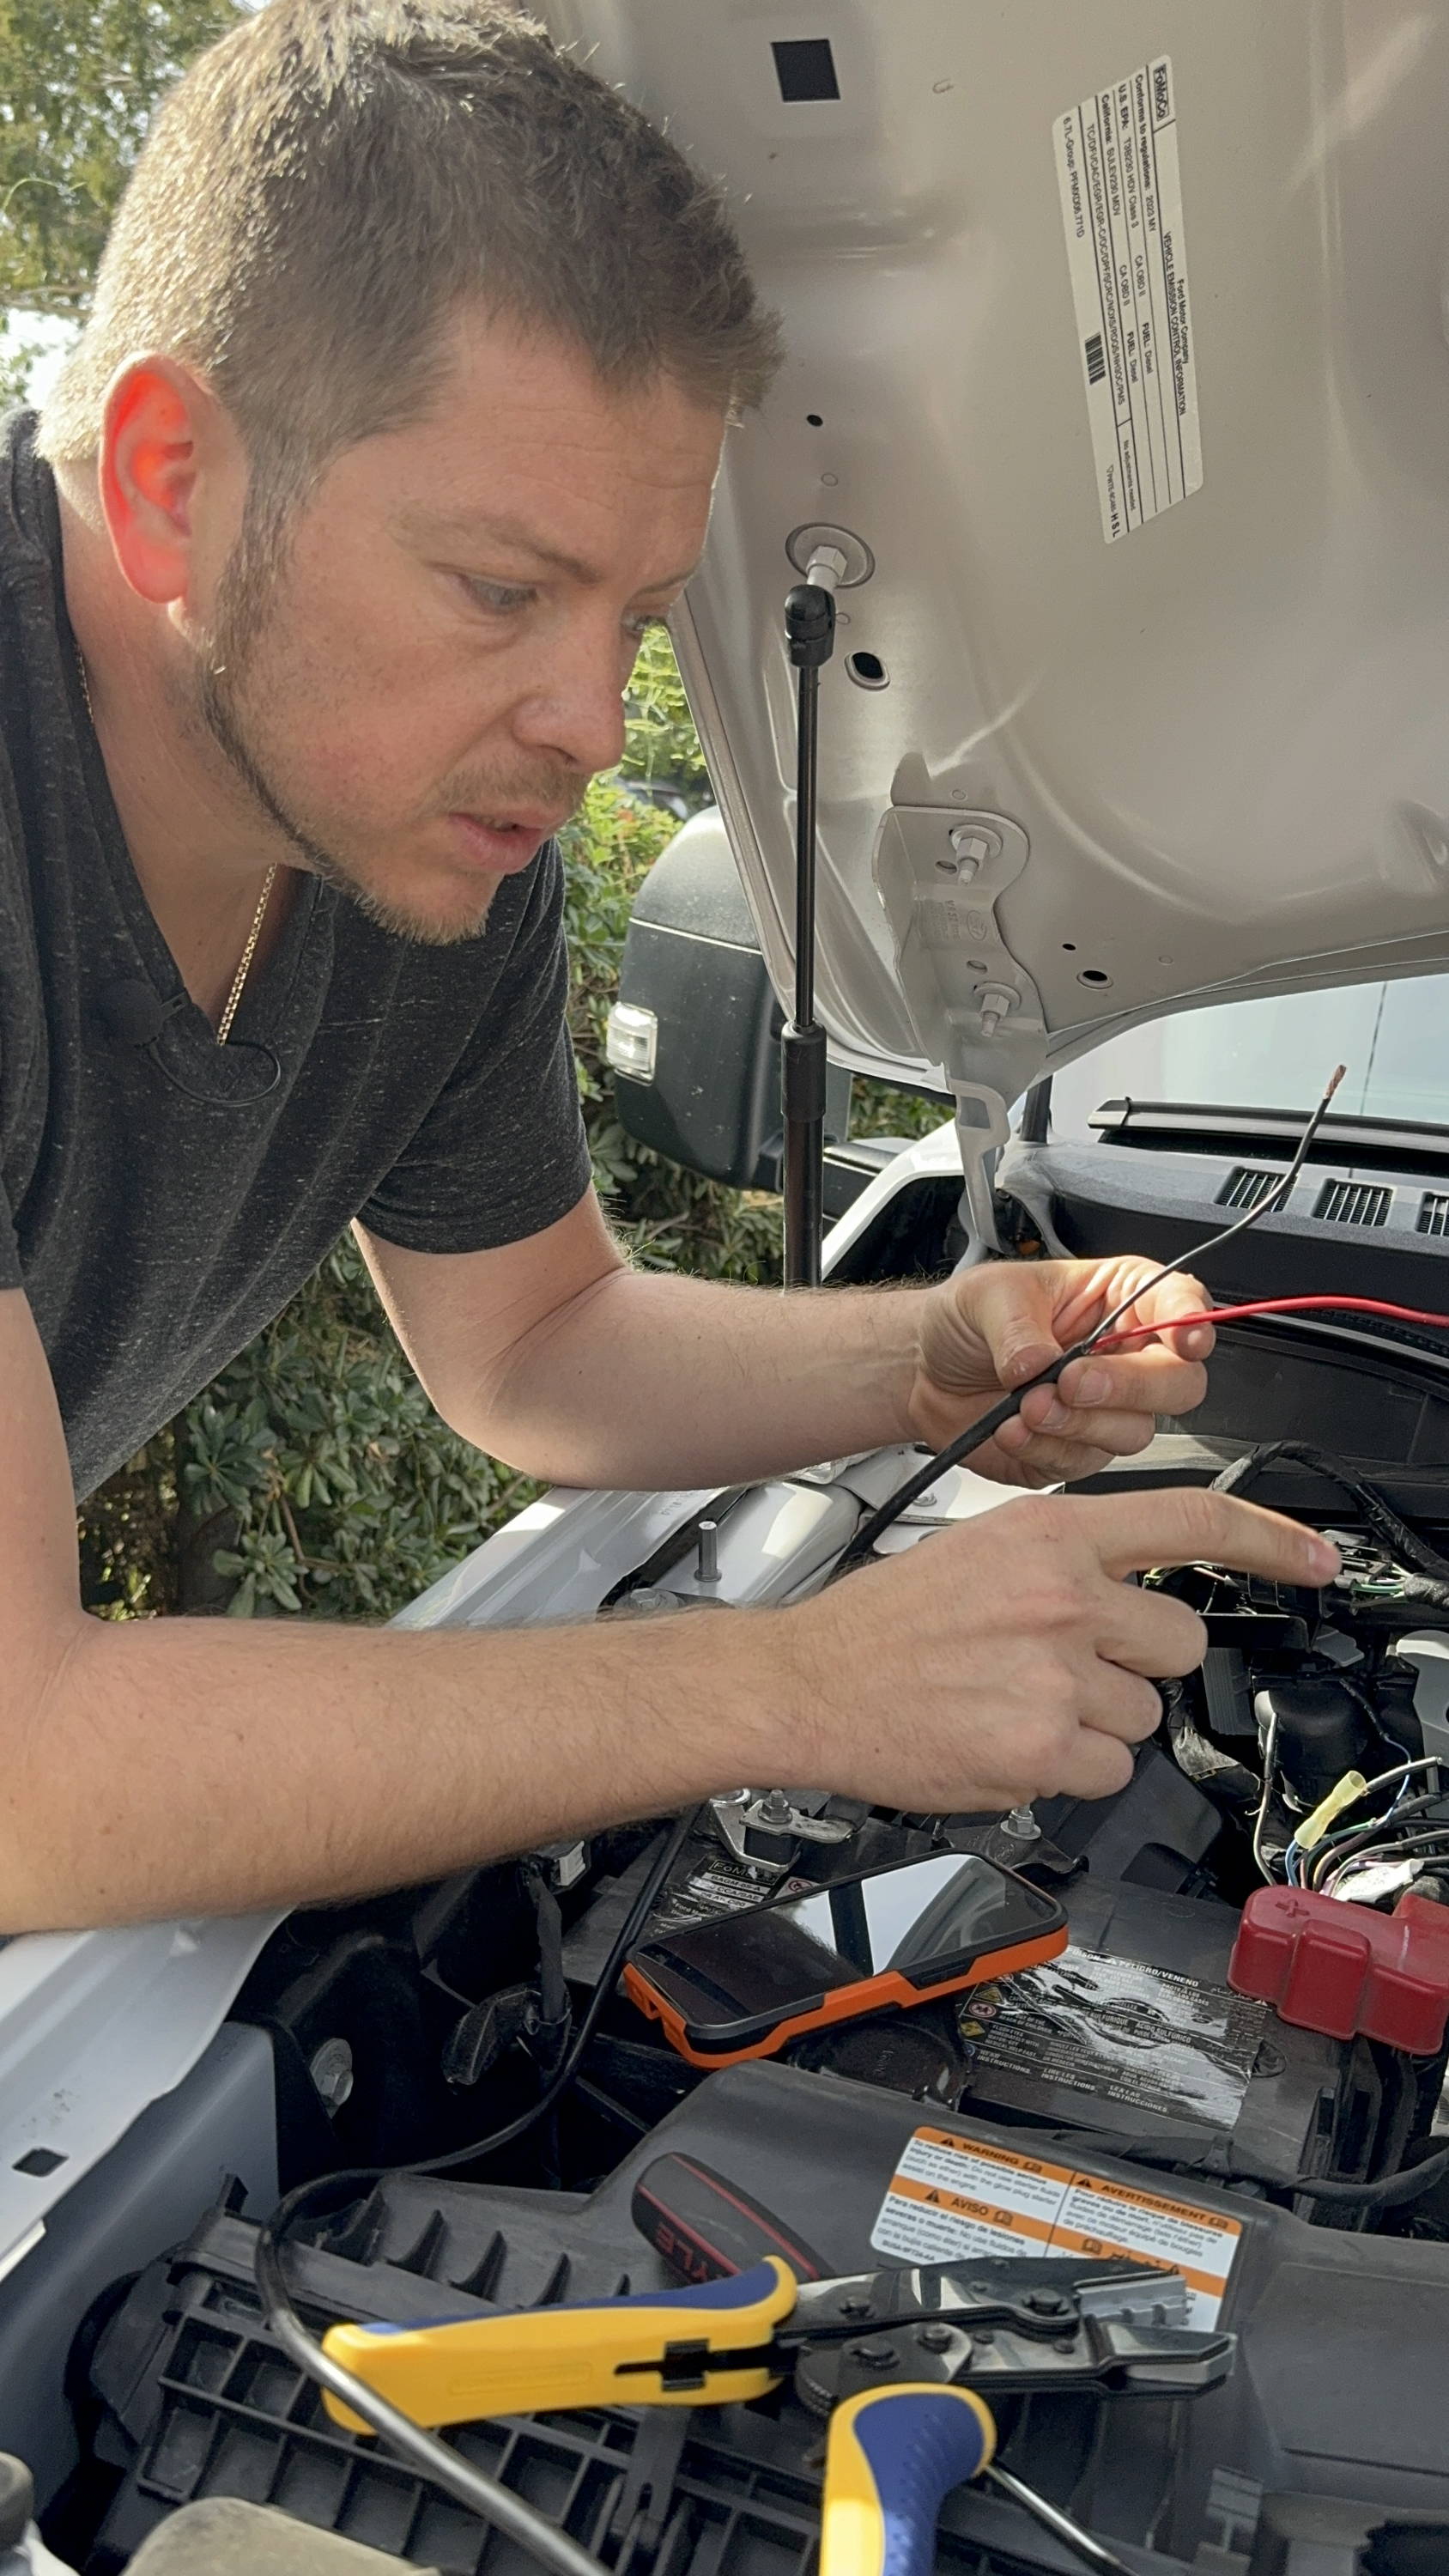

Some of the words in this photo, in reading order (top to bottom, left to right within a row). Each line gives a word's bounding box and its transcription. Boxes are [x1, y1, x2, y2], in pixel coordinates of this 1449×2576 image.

[1118, 82, 1127, 106] U.S.
[1134, 73, 1147, 123] Conforms
[1153, 64, 1169, 121] FoMoCo
[1100, 93, 1113, 145] California:
[1119, 105, 1129, 131] EPA:
[1139, 122, 1147, 136] to
[1061, 115, 1077, 172] 6.7L-Group:
[1106, 146, 1119, 195] SULEV230
[1139, 135, 1152, 191] regulations:
[1126, 172, 1136, 195] HDV
[1111, 193, 1121, 218] MDV
[1128, 193, 1137, 221] Class
[1145, 193, 1155, 218] 2023
[1148, 216, 1155, 234] MY
[1134, 253, 1143, 270] CA
[1163, 231, 1173, 272] VEHICLE
[1119, 263, 1127, 279] CA
[1136, 268, 1145, 291] OBD
[1119, 277, 1130, 301] OBD
[1138, 289, 1145, 298] II
[1167, 270, 1177, 316] EMISSION
[1176, 277, 1185, 301] Ford
[1178, 300, 1186, 326] Motor
[1126, 330, 1136, 357] FUEL:
[1141, 320, 1150, 349] FUEL:
[1170, 314, 1180, 358] CONTROL
[1179, 325, 1190, 367] Company
[1129, 358, 1138, 384] Diesel
[1144, 349, 1153, 375] Diesel
[1174, 357, 1185, 416] INFORMATION
[1123, 438, 1129, 451] No
[1123, 449, 1133, 489] adjustments
[1118, 1959, 1199, 1988] PELIGRO/VENENO
[924, 2143, 952, 2155] reduce
[953, 2152, 969, 2161] risk
[979, 2160, 1015, 2176] possible
[1016, 2172, 1047, 2184] serious
[961, 2142, 1020, 2166] WARNING
[901, 2163, 925, 2174] assist
[936, 2173, 949, 2182] the
[908, 2147, 933, 2160] injury
[943, 2157, 971, 2170] death:
[970, 2166, 984, 2174] Do
[997, 2174, 1012, 2183] use
[1013, 2178, 1038, 2190] starter
[1039, 2187, 1060, 2197] fluids
[962, 2172, 979, 2181] with
[979, 2178, 992, 2186] the
[992, 2182, 1012, 2193] glow
[1011, 2188, 1031, 2199] plug
[1031, 2194, 1057, 2206] starter
[1100, 2184, 1207, 2221] AVERTISSEMENT
[888, 2196, 909, 2207] Para
[907, 2202, 939, 2216] reducir
[948, 2215, 977, 2230] riesgo
[976, 2224, 989, 2233] de
[988, 2228, 1026, 2245] lesiones
[949, 2196, 990, 2216] AVISO
[1068, 2202, 1095, 2215] fluides
[1107, 2215, 1153, 2233] démarrage
[1074, 2188, 1094, 2199] Pour
[1095, 2195, 1127, 2208] réduire
[1137, 2208, 1166, 2221] risque
[1179, 2221, 1223, 2238] blessures
[879, 2217, 917, 2233] arranque
[916, 2227, 943, 2242] (como
[883, 2207, 918, 2221] severas
[925, 2220, 959, 2234] muerte:
[958, 2229, 972, 2239] No
[972, 2234, 988, 2244] use
[987, 2239, 1016, 2253] fluidos
[1065, 2210, 1086, 2221] avec
[1098, 2221, 1128, 2233] moteur
[1127, 2228, 1156, 2244] équipé
[1168, 2242, 1203, 2257] bougies
[1114, 2208, 1126, 2216] de
[1188, 2231, 1204, 2240] pas
[876, 2227, 893, 2236] con
[921, 2240, 955, 2256] caliente
